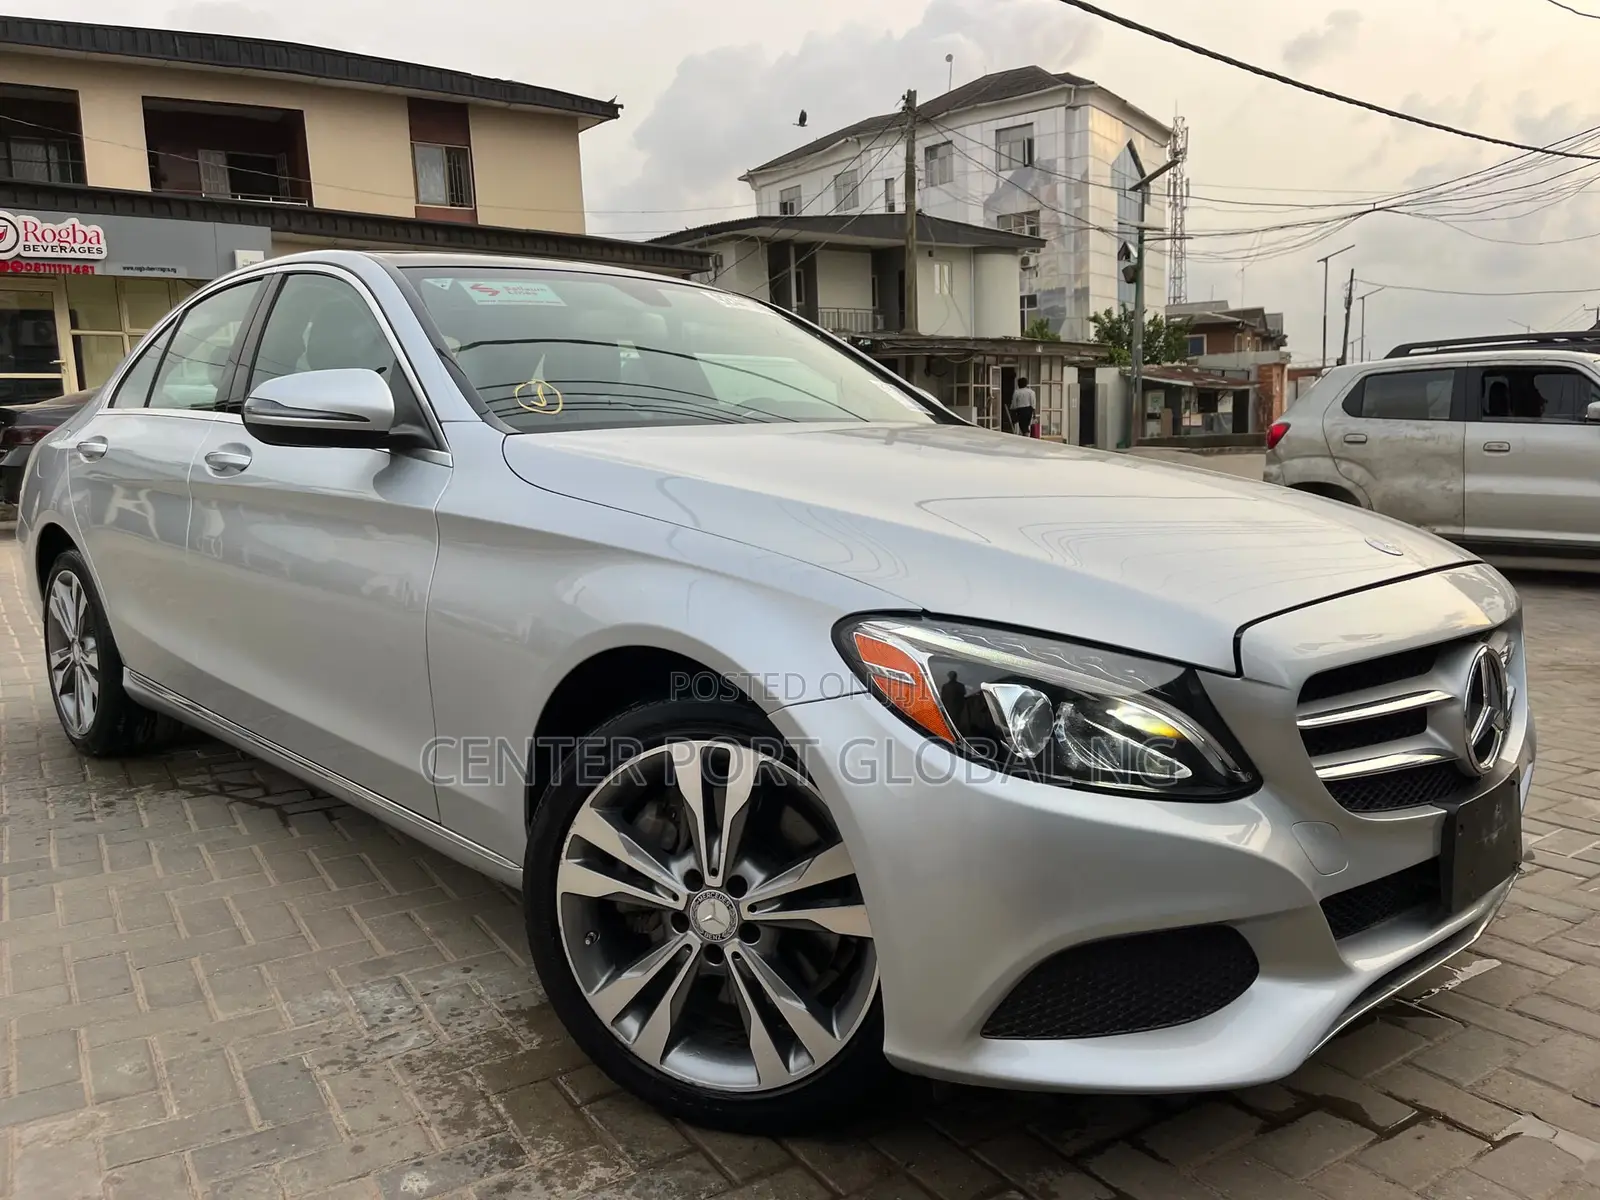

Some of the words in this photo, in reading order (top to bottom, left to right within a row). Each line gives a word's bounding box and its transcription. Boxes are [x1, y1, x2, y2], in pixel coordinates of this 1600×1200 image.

[23, 220, 101, 248] Rogba
[23, 244, 104, 255] BEVERAGES
[697, 892, 731, 907] MERCEDES
